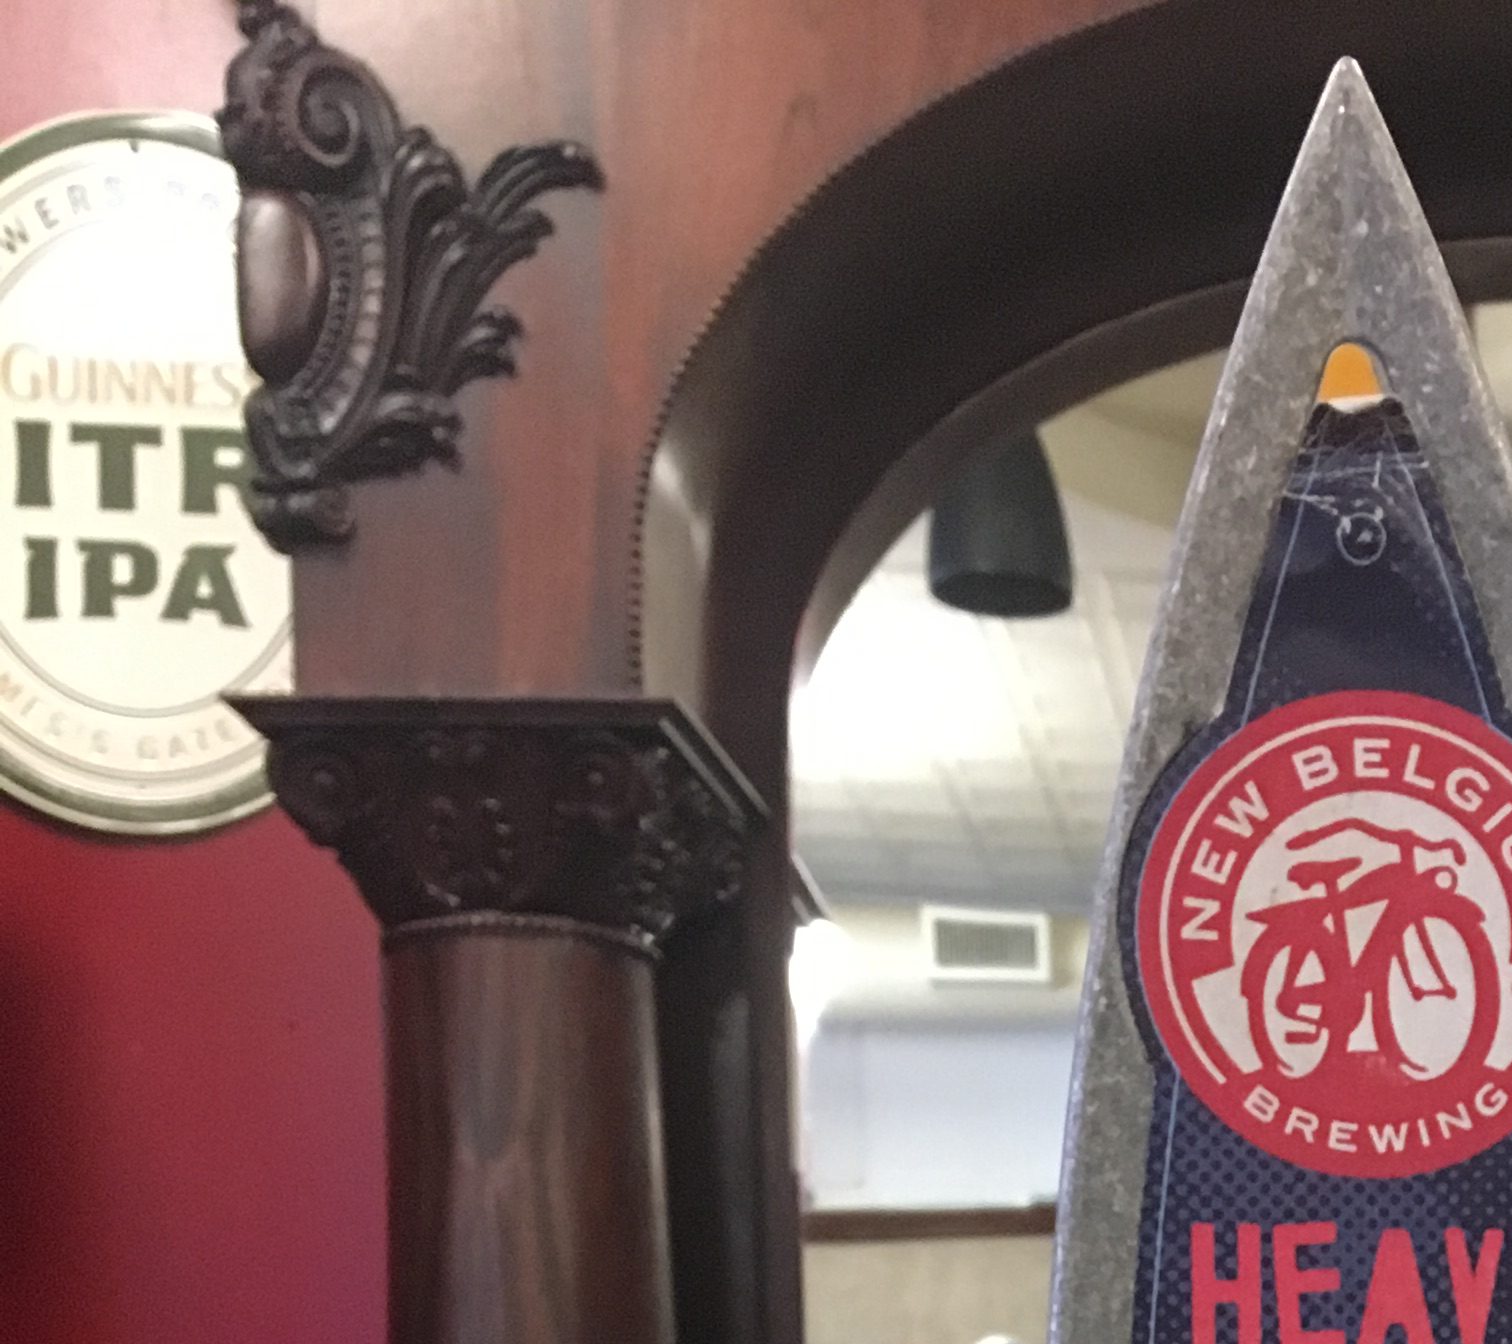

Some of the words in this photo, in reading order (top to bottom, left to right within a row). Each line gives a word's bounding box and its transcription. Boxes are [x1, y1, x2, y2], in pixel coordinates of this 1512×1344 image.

[24, 535, 251, 630] IPA
[1181, 780, 1270, 942] NEW
[1243, 1082, 1510, 1155] BREWING
